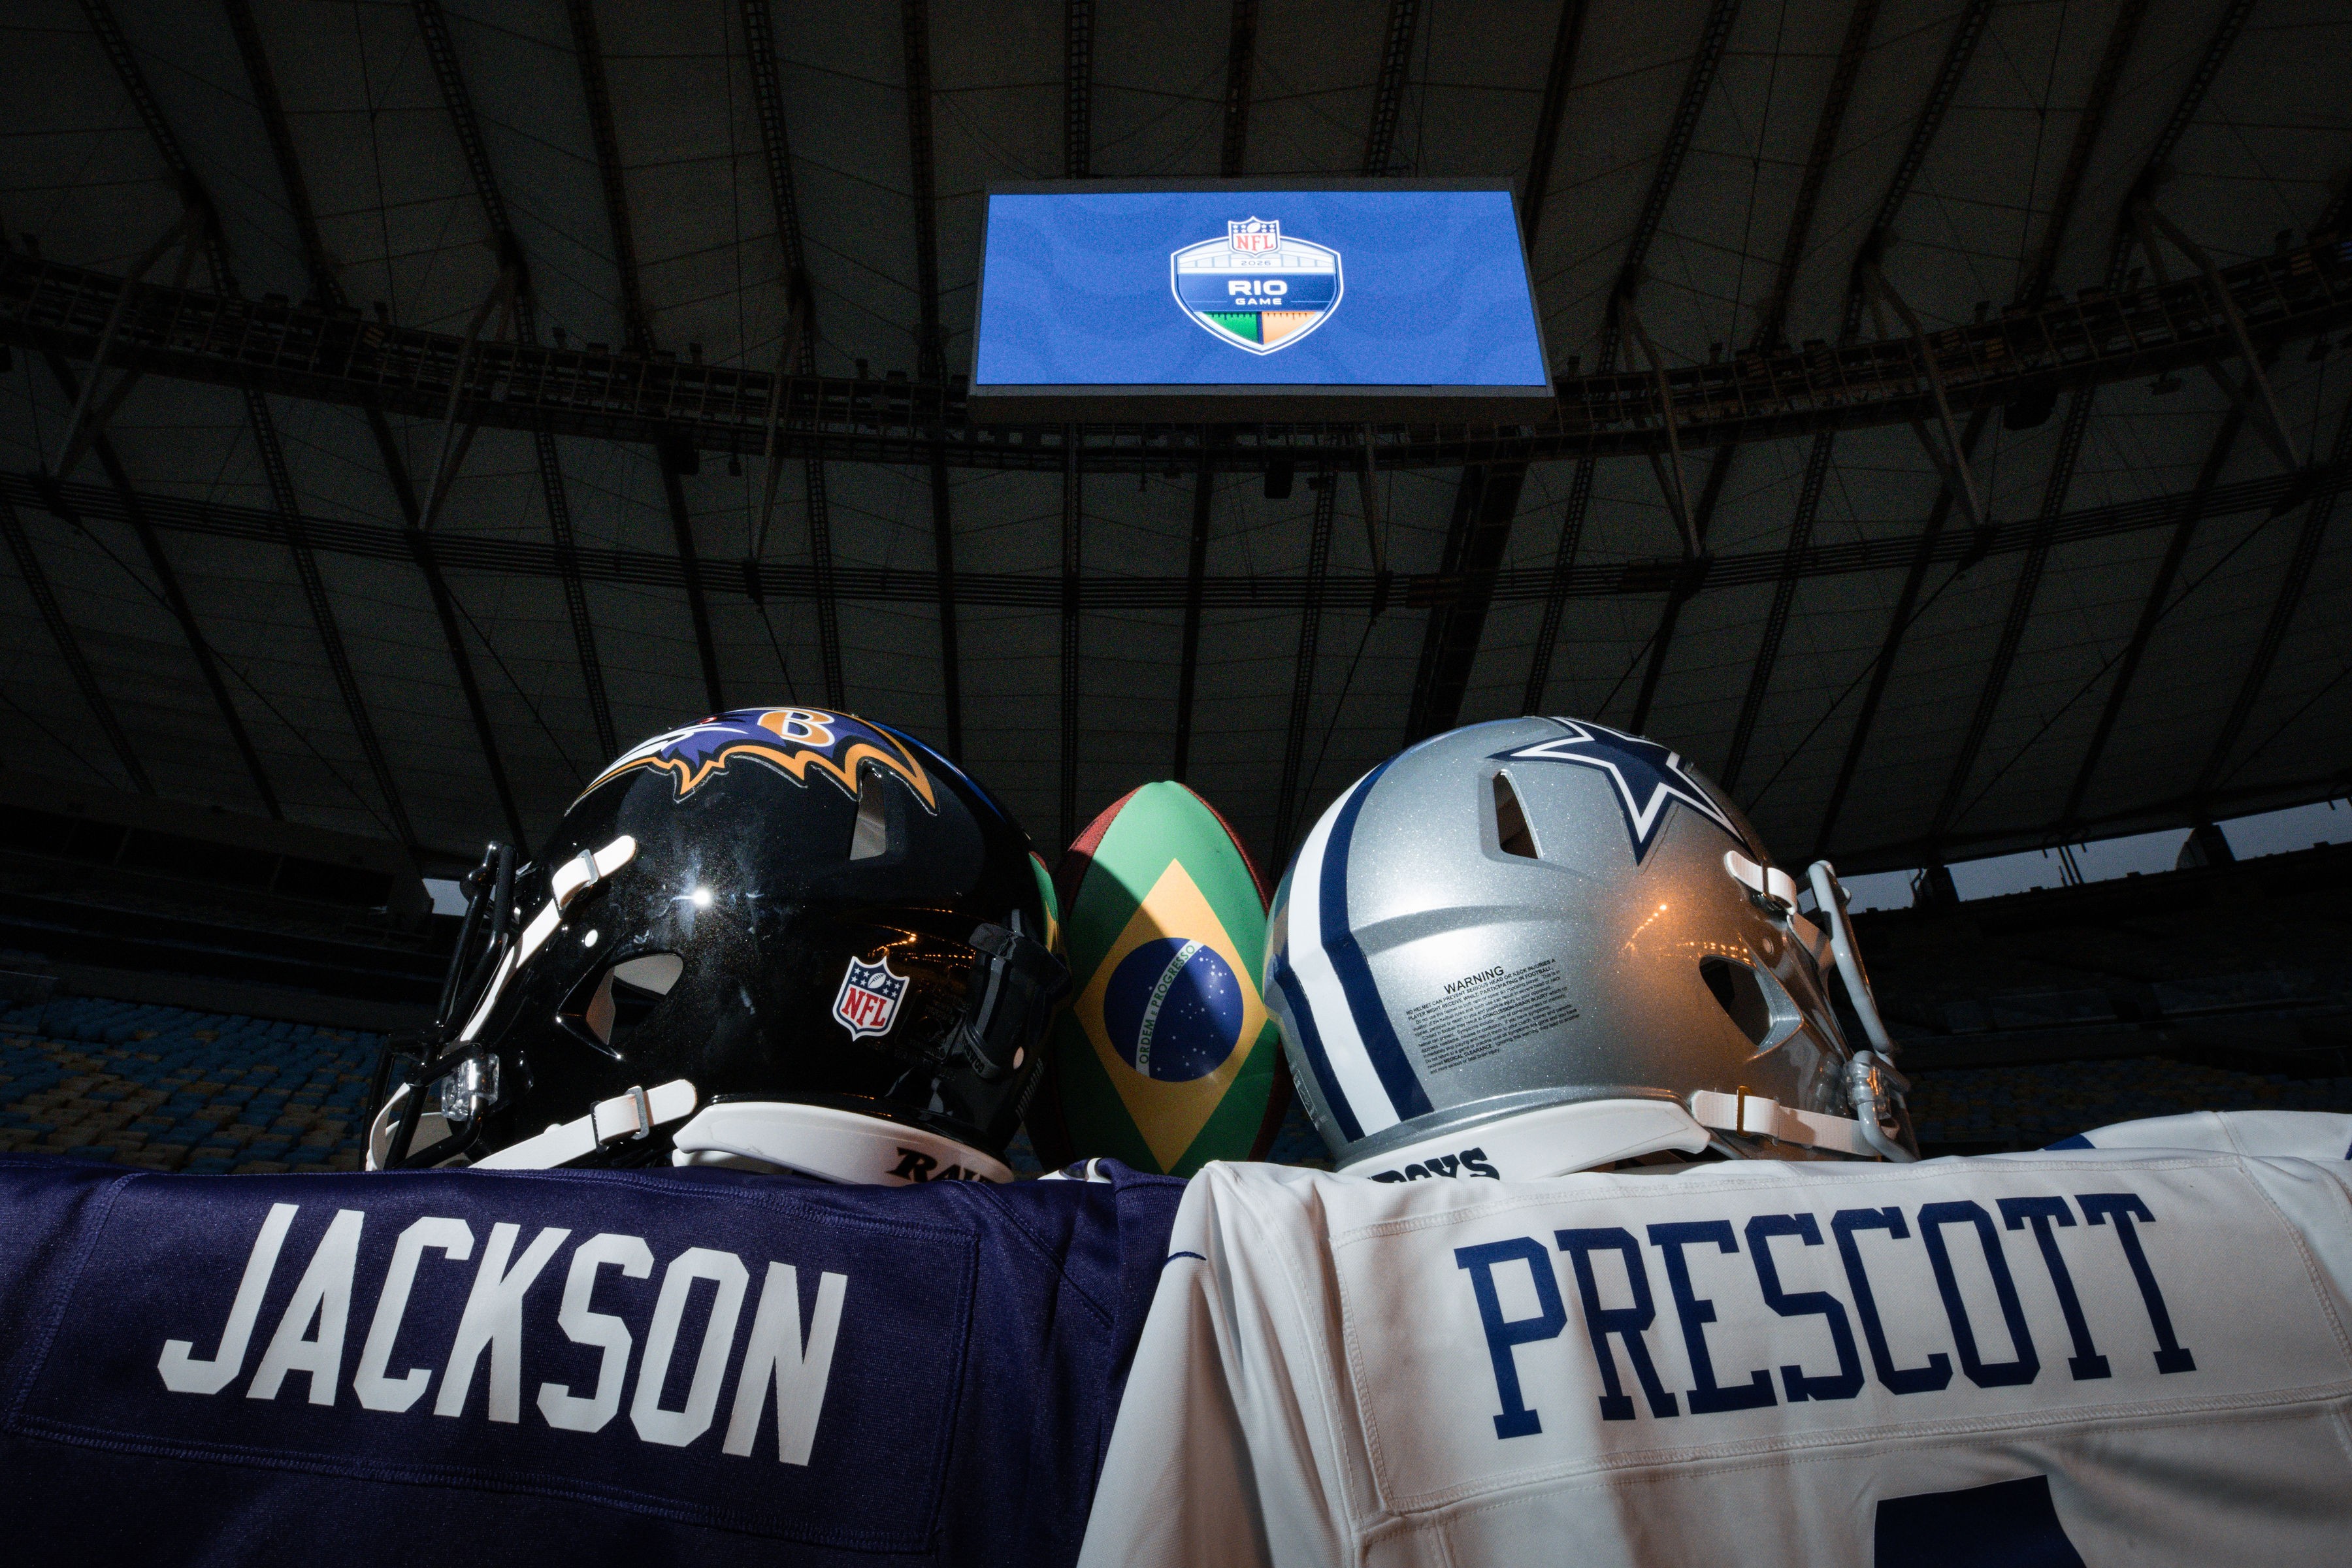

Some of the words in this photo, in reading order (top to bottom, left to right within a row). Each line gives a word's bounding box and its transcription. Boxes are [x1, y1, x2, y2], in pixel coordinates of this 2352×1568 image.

[1235, 235, 1273, 252] NFL
[1228, 280, 1287, 295] RIO
[1407, 1010, 1427, 1021] PLAYER
[1426, 1005, 1442, 1015] MIGHT
[1441, 997, 1463, 1009] RECEIVE
[1462, 991, 1480, 1002] WHILE
[1479, 977, 1518, 996] PARTICIPATING
[1413, 1002, 1432, 1013] HELMET
[1431, 998, 1443, 1007] CAN
[1442, 990, 1466, 1003] PREVENT
[1465, 981, 1489, 994] SERIOUS
[1488, 976, 1504, 986] HEAD
[1512, 968, 1528, 977] NECK
[1527, 959, 1552, 972] INJURIES
[1443, 964, 1505, 996] WARNING
[1530, 992, 1549, 1003] INJURY
[841, 987, 887, 1027] NFL
[1139, 1019, 1155, 1065] ORDEM
[1151, 945, 1196, 1007] PROGRESSO
[157, 1202, 848, 1467] JACKSON
[1454, 1192, 2197, 1440] PRESCOTT
